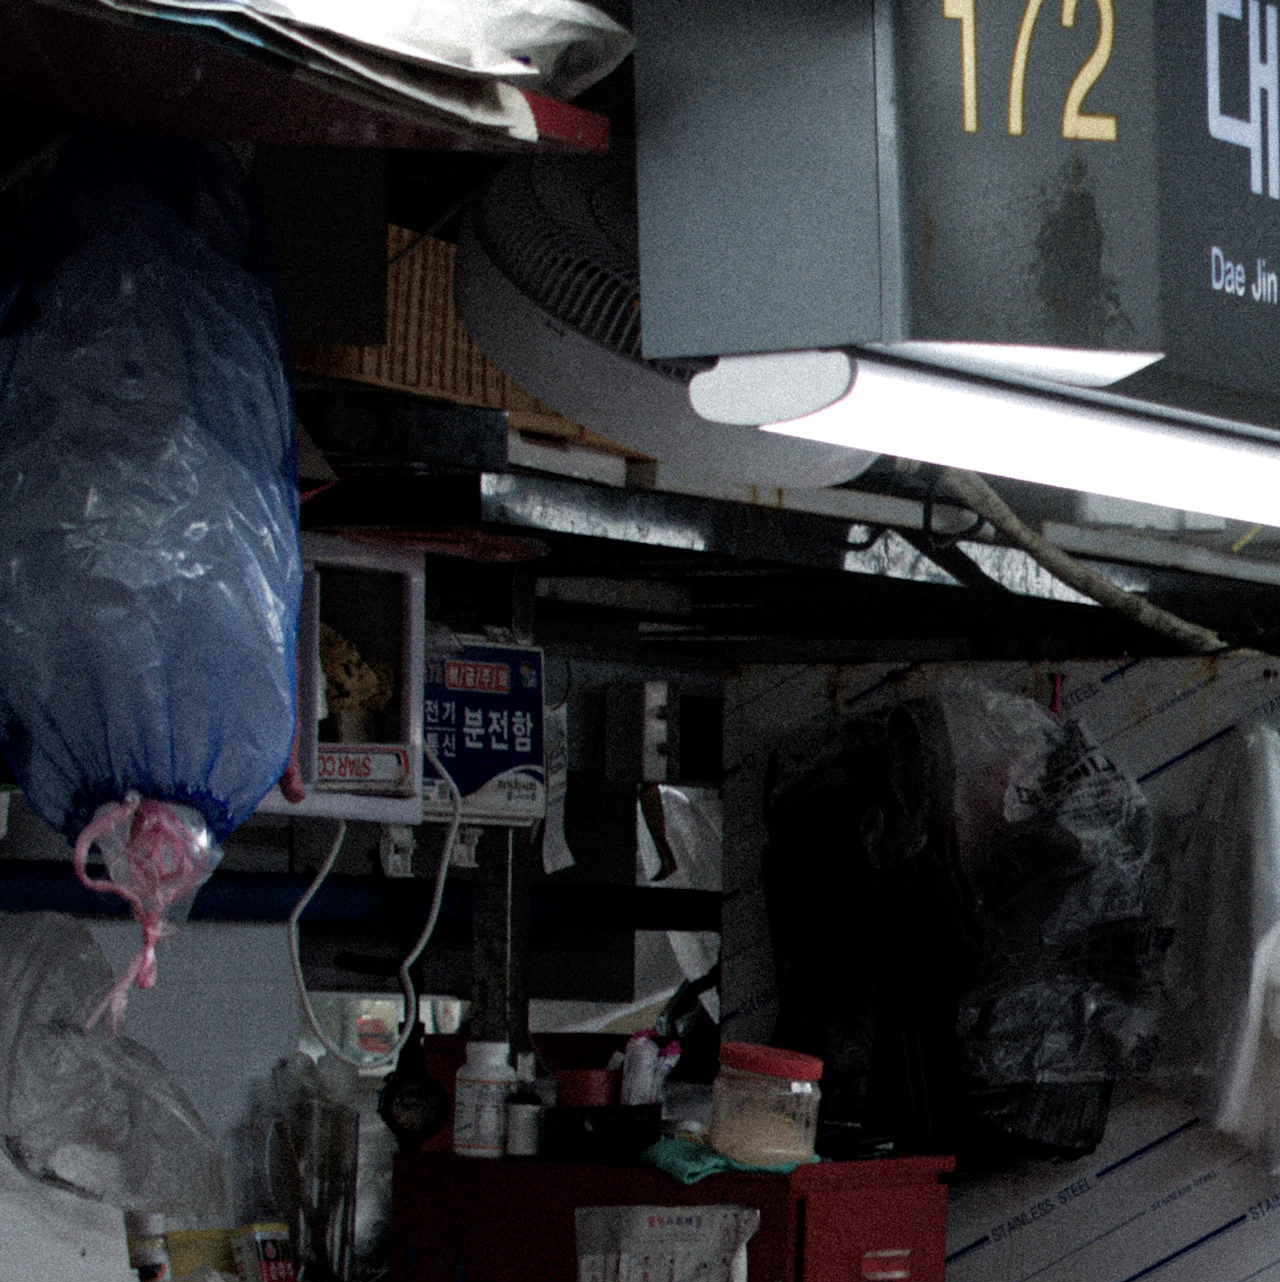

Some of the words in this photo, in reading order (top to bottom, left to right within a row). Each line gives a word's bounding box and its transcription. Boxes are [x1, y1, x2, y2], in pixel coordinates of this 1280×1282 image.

[942, 0, 1118, 142] 172
[1211, 246, 1245, 298] Dae
[1251, 258, 1278, 305] Jin
[462, 703, 535, 755] 분전함
[988, 1197, 1055, 1243] STAINLESS
[1056, 1178, 1093, 1206] STEEL
